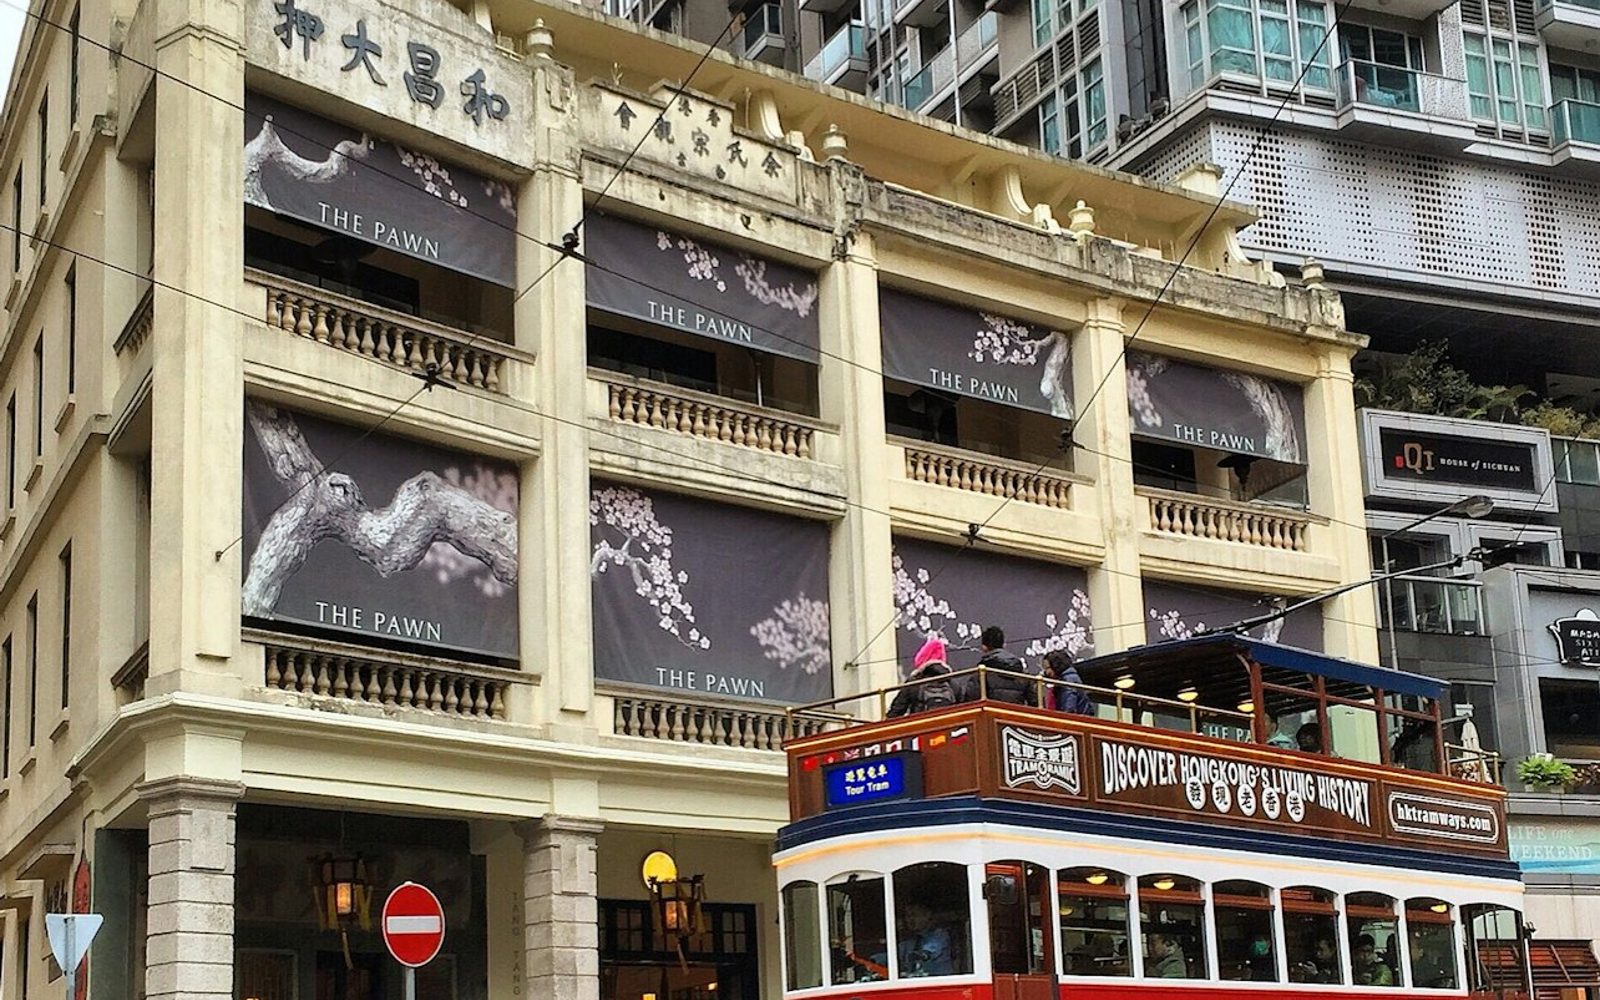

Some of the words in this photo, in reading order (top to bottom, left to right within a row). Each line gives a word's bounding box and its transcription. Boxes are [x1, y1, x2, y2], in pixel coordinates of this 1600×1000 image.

[318, 201, 362, 234] THE
[374, 221, 439, 259] PAWN
[648, 300, 686, 326] THE
[695, 313, 752, 342] PAWN
[929, 367, 962, 391] THE
[970, 377, 1018, 403] PAWN
[1173, 423, 1204, 443] THE
[1211, 430, 1255, 452] PAWN
[1440, 457, 1468, 467] HOUSE
[1471, 460, 1480, 470] of
[1482, 462, 1520, 472] SICHUAN
[316, 601, 362, 629] THE
[374, 611, 440, 641] PAWN
[656, 667, 696, 690] THE
[706, 673, 764, 697] PAWN
[1203, 724, 1229, 740] HE
[845, 785, 864, 796] Tour
[866, 781, 890, 792] Tram
[1101, 741, 1178, 795] DISCOVER
[1271, 768, 1315, 803] LIVING
[1317, 775, 1371, 827] HISTORY
[1396, 802, 1492, 831] hktramways.com
[512, 950, 521, 996] TANG
